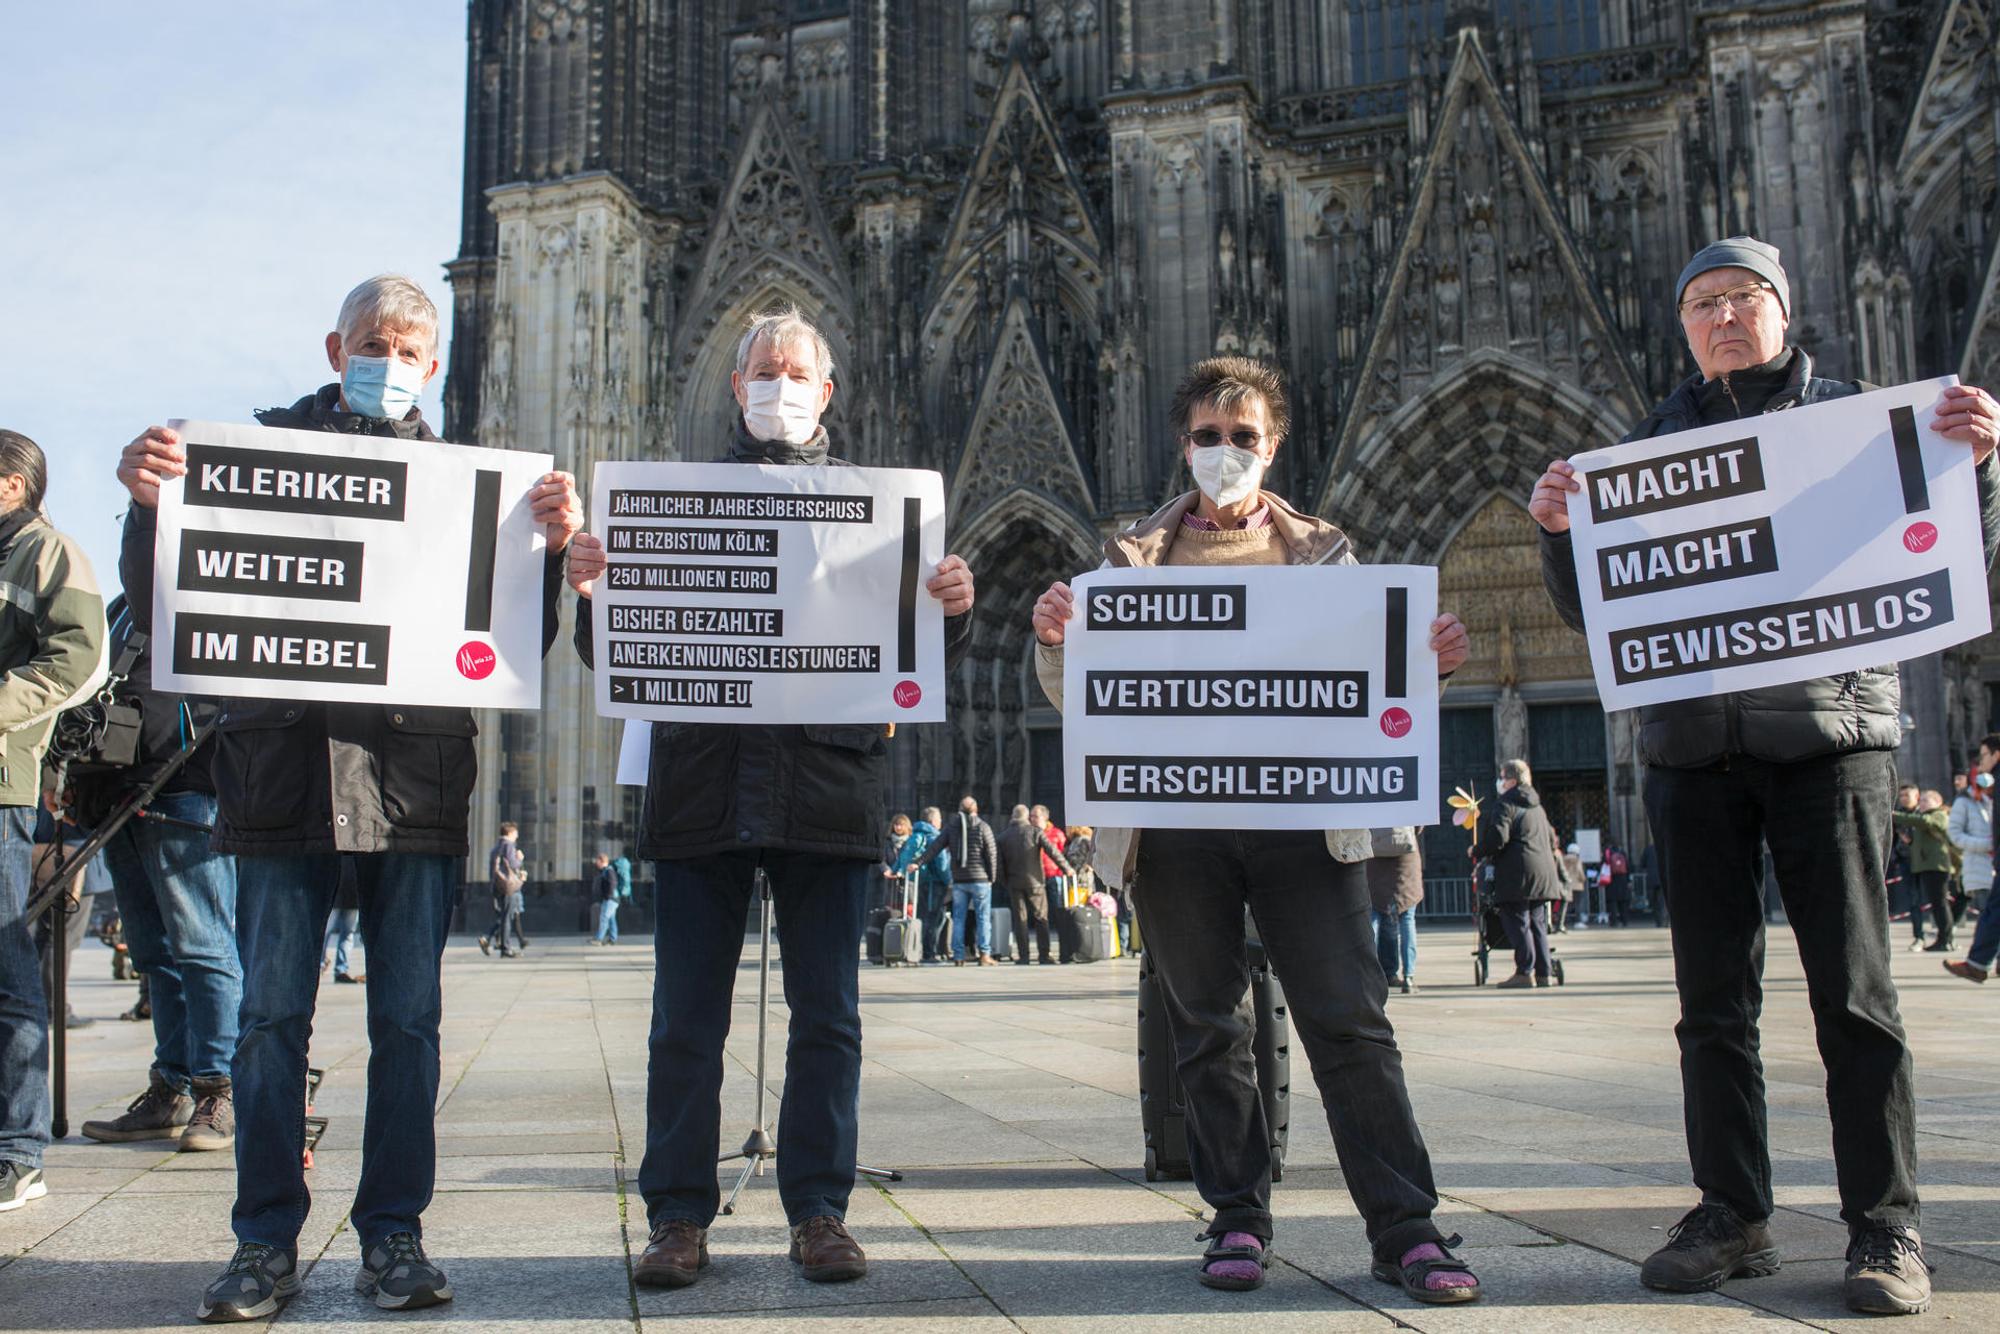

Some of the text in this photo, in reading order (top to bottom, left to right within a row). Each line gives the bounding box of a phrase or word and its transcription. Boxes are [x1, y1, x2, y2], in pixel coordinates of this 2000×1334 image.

[201, 463, 392, 506] KLERIKER
[1596, 448, 1745, 510] MACHT
[613, 492, 866, 520] JÄHRLICHER JAHRESÜBERSCHUSS
[613, 530, 770, 552] IM ERZBISTUM KÖLN:
[196, 549, 345, 586] WEITER
[1607, 528, 1758, 587] MACHT
[611, 567, 770, 589] 250 MILLIONEN EURO
[612, 607, 775, 634] BISHER GEZAHLTE
[1092, 593, 1234, 623] SCHULD
[1620, 587, 1933, 674] GEWISSENLOS
[191, 631, 377, 670] IM NEBEL
[612, 643, 877, 669] ANERKENNUNGSLEISTUNGEN:
[631, 679, 639, 701] 1
[645, 680, 719, 704] MILLION
[1092, 679, 1359, 709] VERTUSCHUNG
[1091, 764, 1404, 796] VERSCHLEPPUNG
